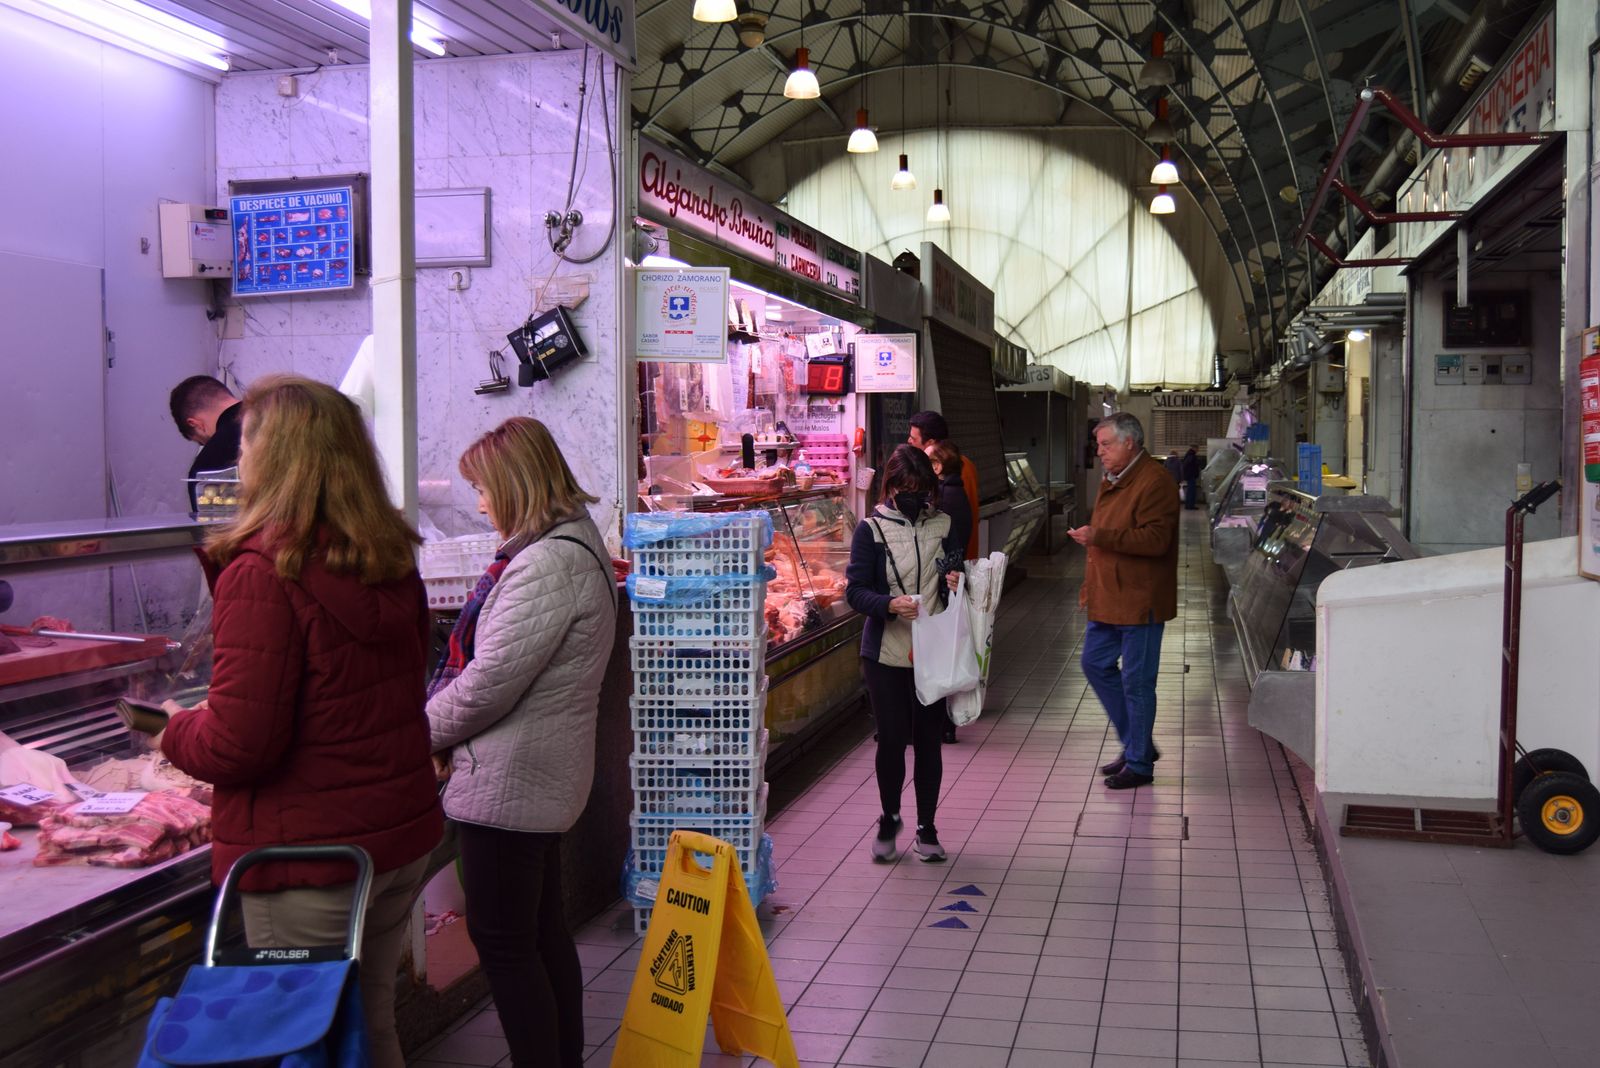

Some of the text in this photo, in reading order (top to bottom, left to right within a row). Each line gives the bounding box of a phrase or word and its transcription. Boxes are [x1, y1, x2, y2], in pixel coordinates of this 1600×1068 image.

[641, 152, 728, 218] Alejandro
[240, 192, 342, 212] DESPIECE DE VACUNO
[641, 274, 674, 282] CHORIZO
[824, 366, 843, 390] 8
[666, 887, 710, 916] CAUTION
[268, 949, 310, 959] ROLSER
[650, 929, 696, 991] ACHTUNG ATTENTION
[650, 992, 684, 1014] CUIDADO
